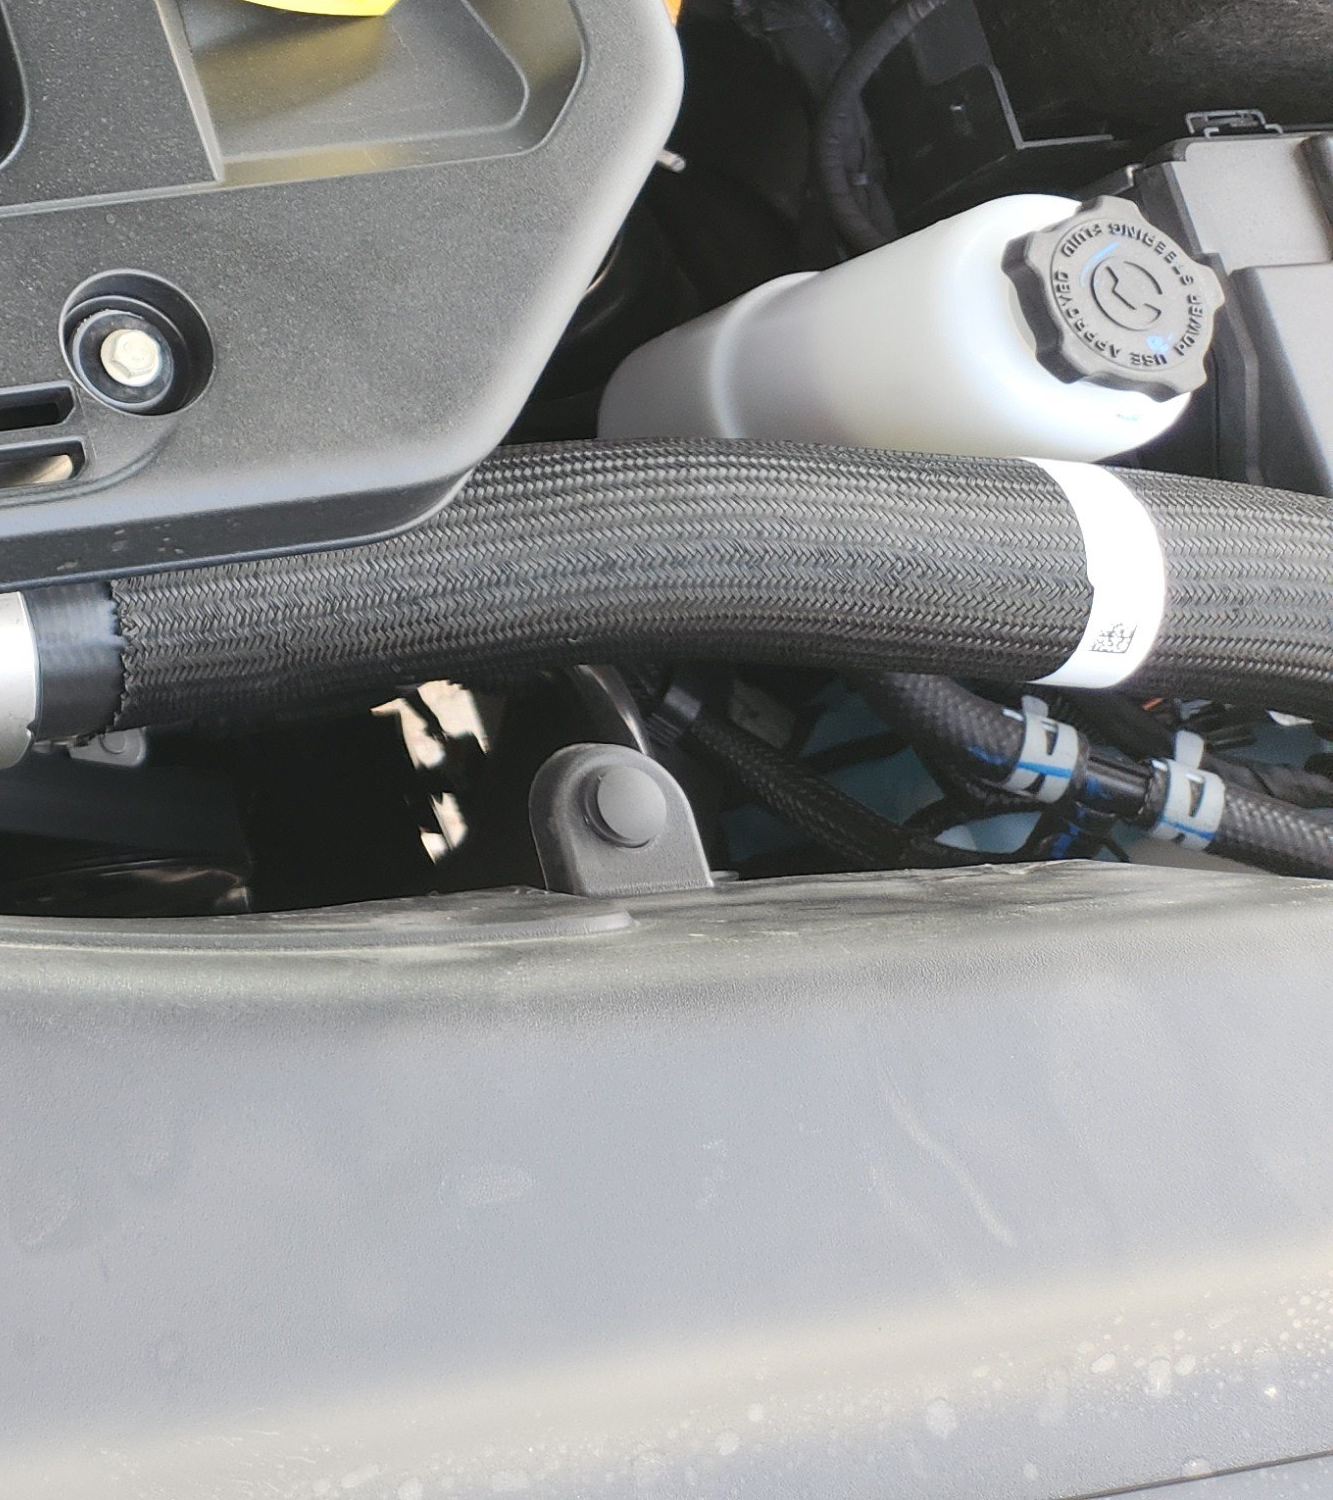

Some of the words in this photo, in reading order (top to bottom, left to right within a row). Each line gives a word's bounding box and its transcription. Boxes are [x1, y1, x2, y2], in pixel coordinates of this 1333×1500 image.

[1061, 223, 1102, 258] FLUID
[1107, 222, 1195, 287] STEERING
[1054, 270, 1121, 358] APPROVED
[1173, 294, 1204, 356] POWER
[1129, 350, 1168, 366] USE
